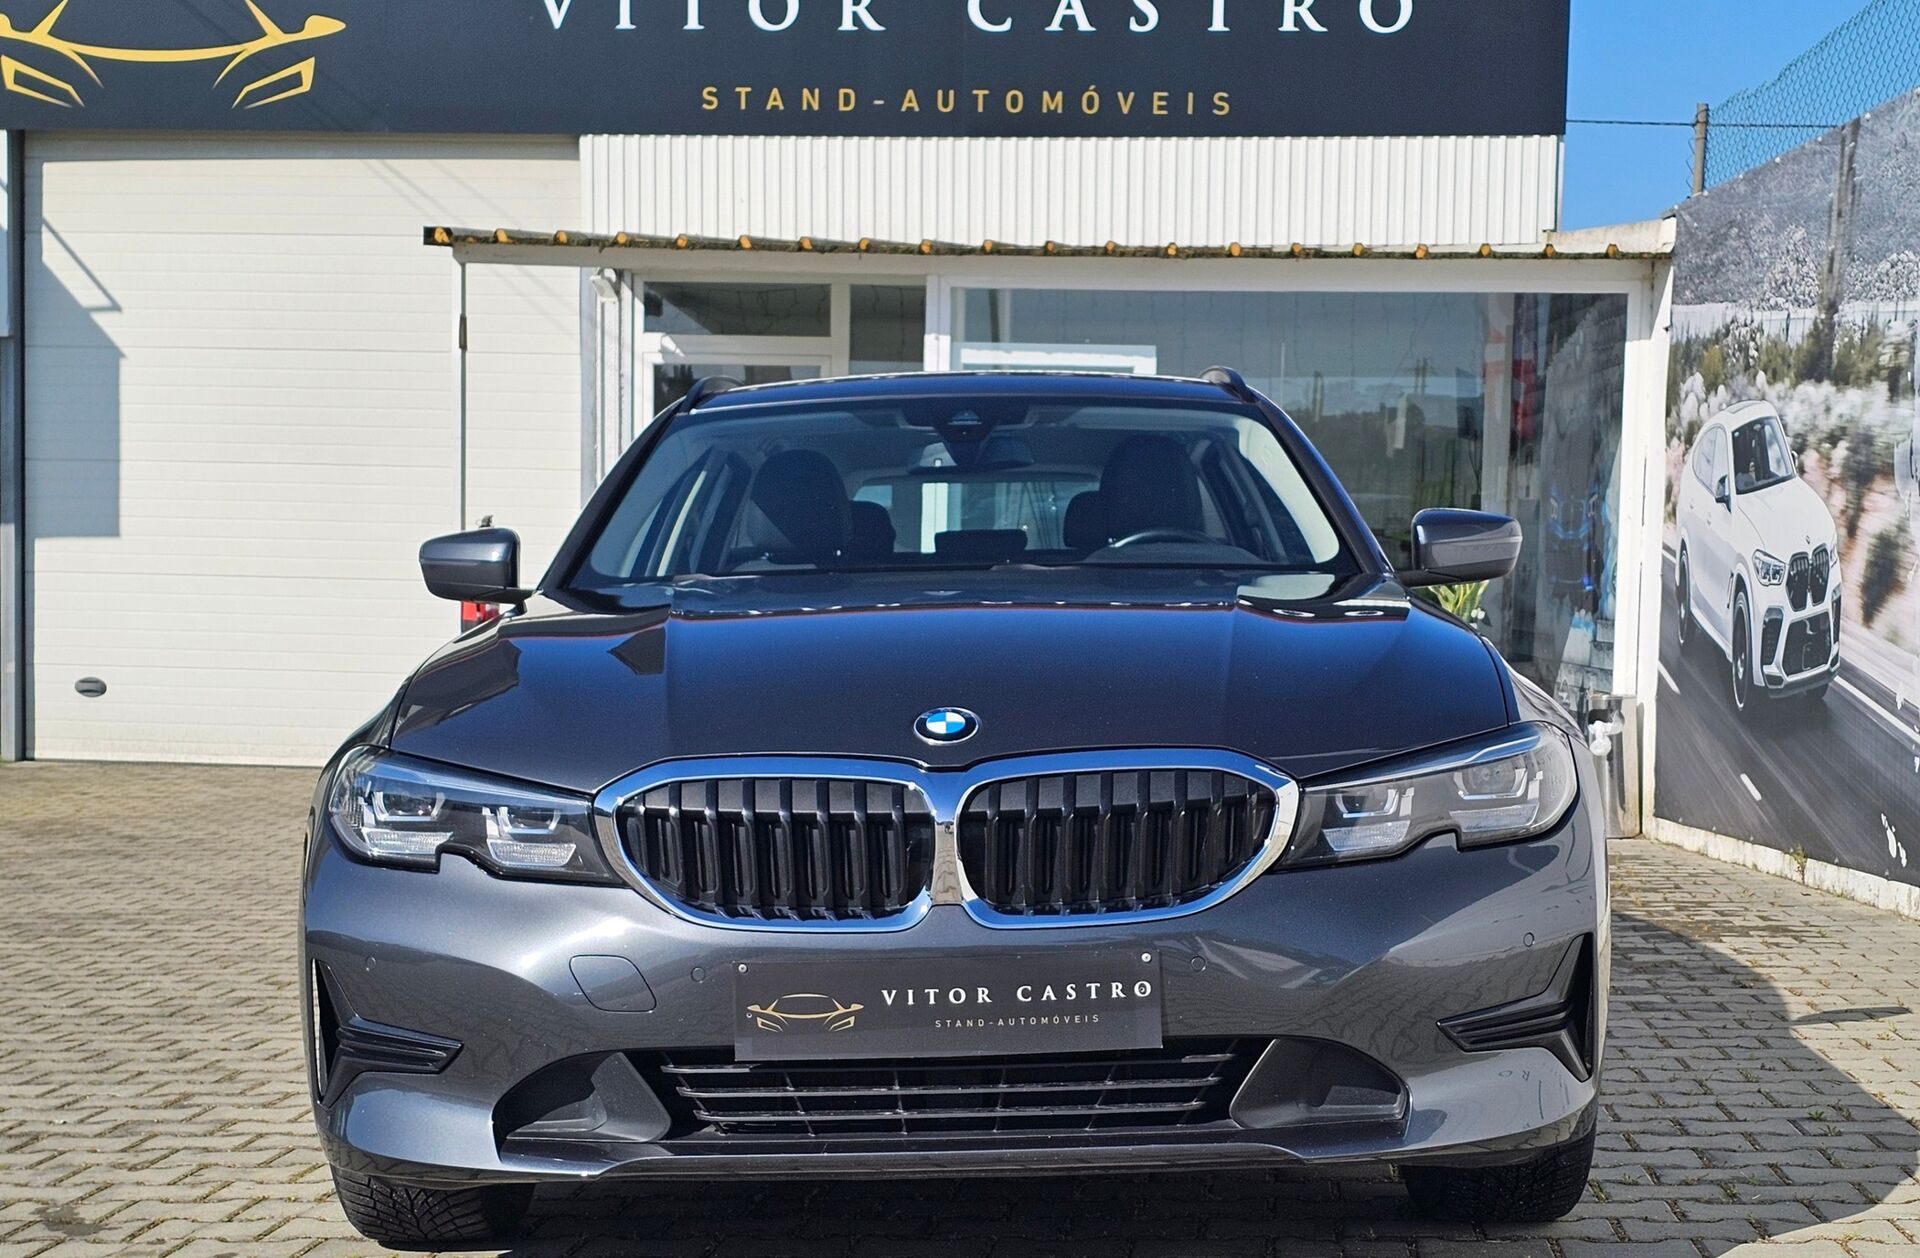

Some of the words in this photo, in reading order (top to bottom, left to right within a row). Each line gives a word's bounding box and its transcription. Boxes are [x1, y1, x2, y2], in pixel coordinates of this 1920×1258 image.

[700, 84, 1231, 117] STAND-AUTOMÓVEIS
[881, 986, 993, 1006] VITOR
[1015, 980, 1152, 1002] CASTRO
[934, 1013, 1100, 1029] STAND-AUTOMÓVEIS
